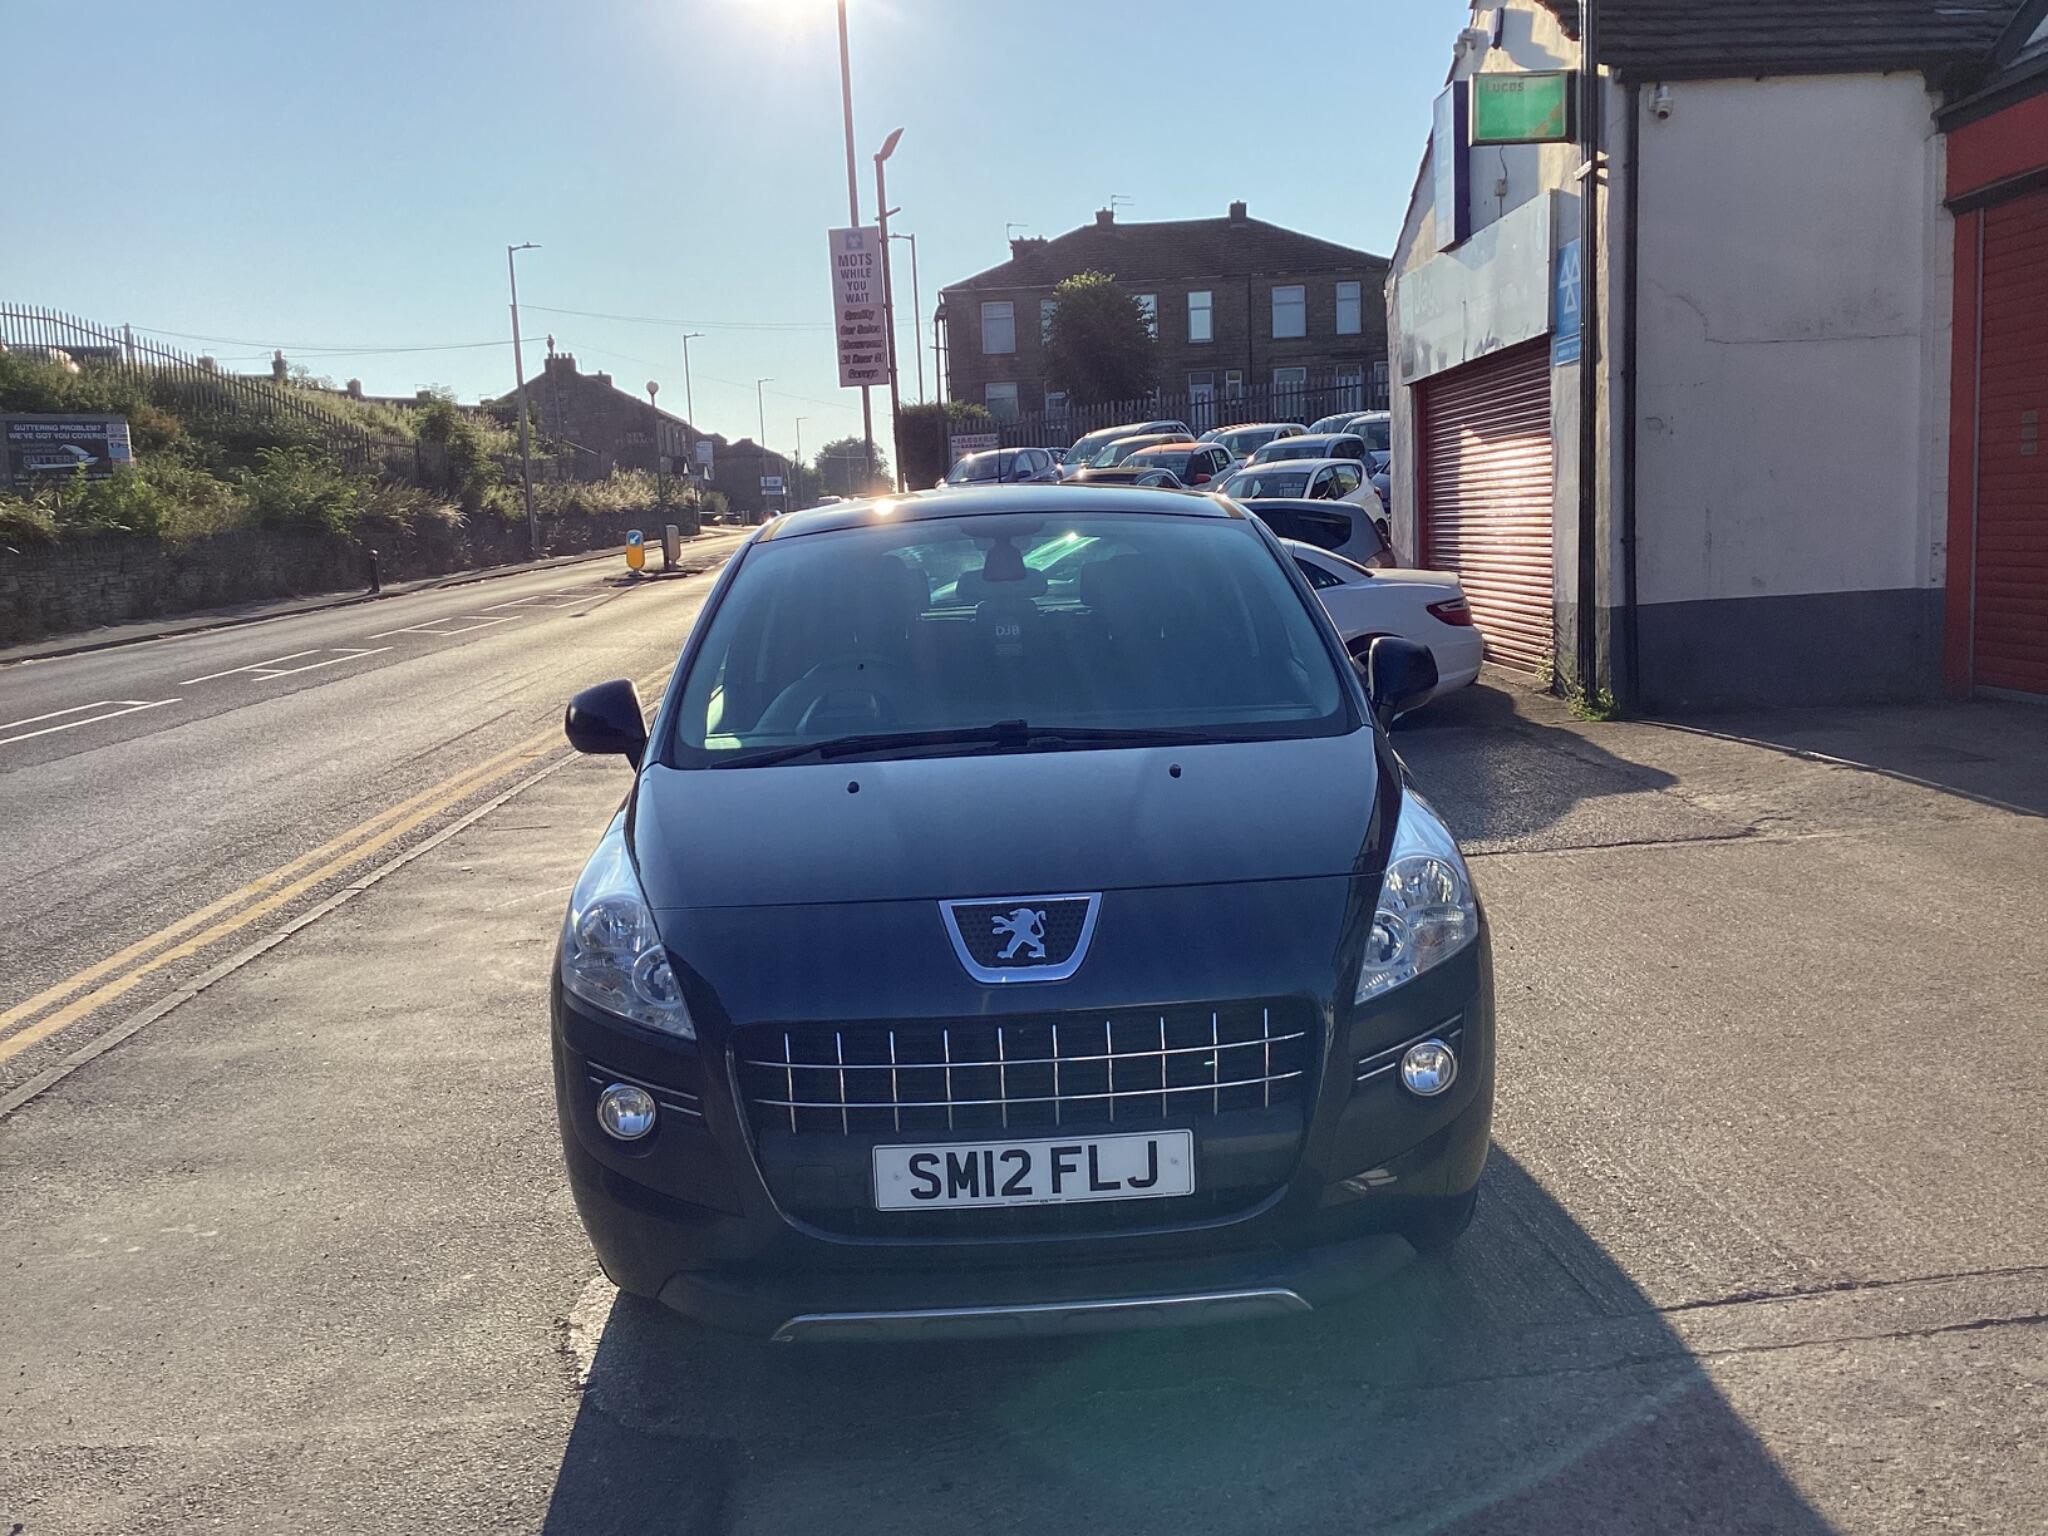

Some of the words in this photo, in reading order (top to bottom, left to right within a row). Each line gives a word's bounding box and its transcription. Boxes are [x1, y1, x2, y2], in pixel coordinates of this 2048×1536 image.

[838, 253, 872, 266] MOTS
[840, 268, 871, 279] WHILE
[847, 281, 867, 291] YOU
[845, 293, 870, 303] WAIT
[909, 1149, 1033, 1200] SM12
[1050, 1140, 1158, 1194] FLJ
